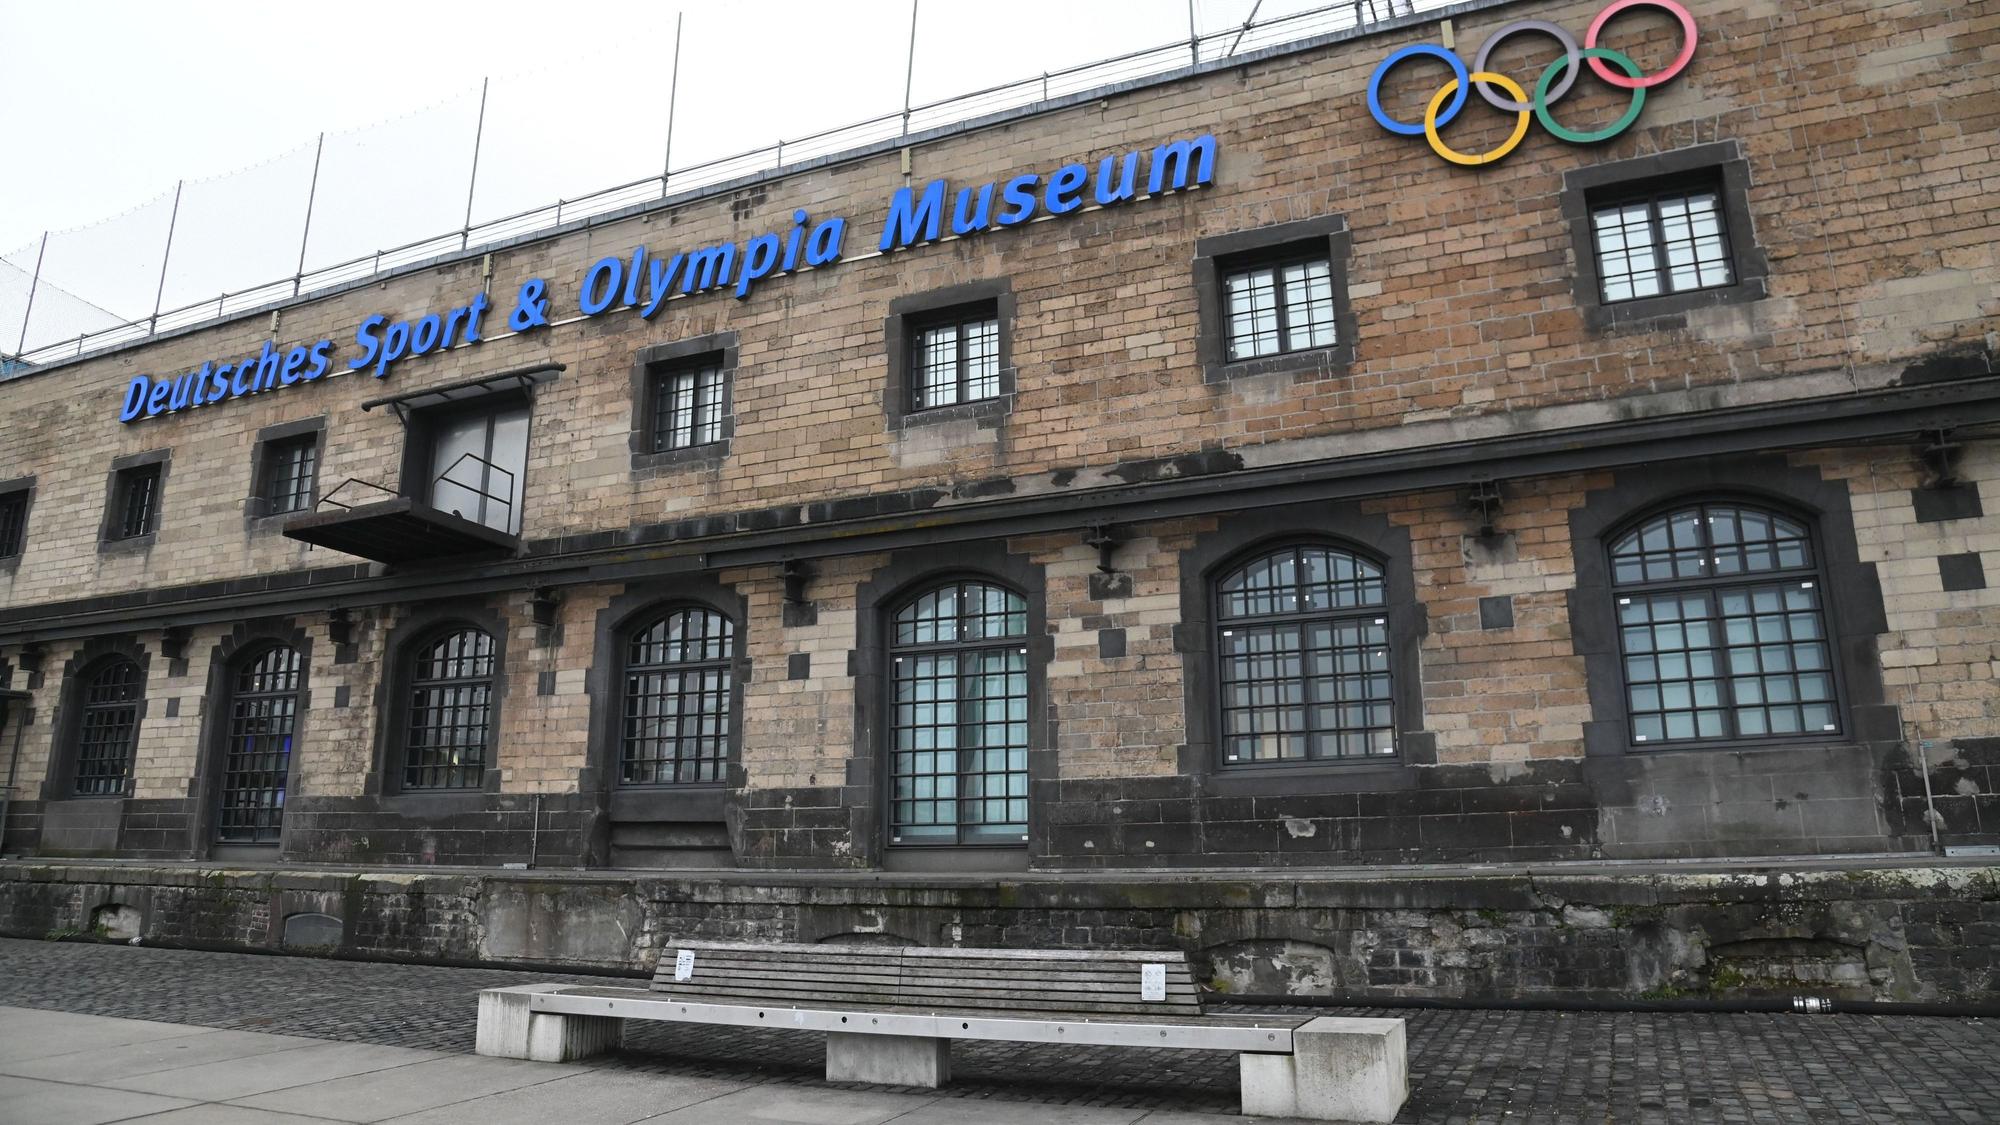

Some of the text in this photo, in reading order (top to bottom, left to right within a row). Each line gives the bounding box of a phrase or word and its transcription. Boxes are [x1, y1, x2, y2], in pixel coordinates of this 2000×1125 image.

[119, 134, 1218, 422] Deutsches Sport & Olympia Museum
